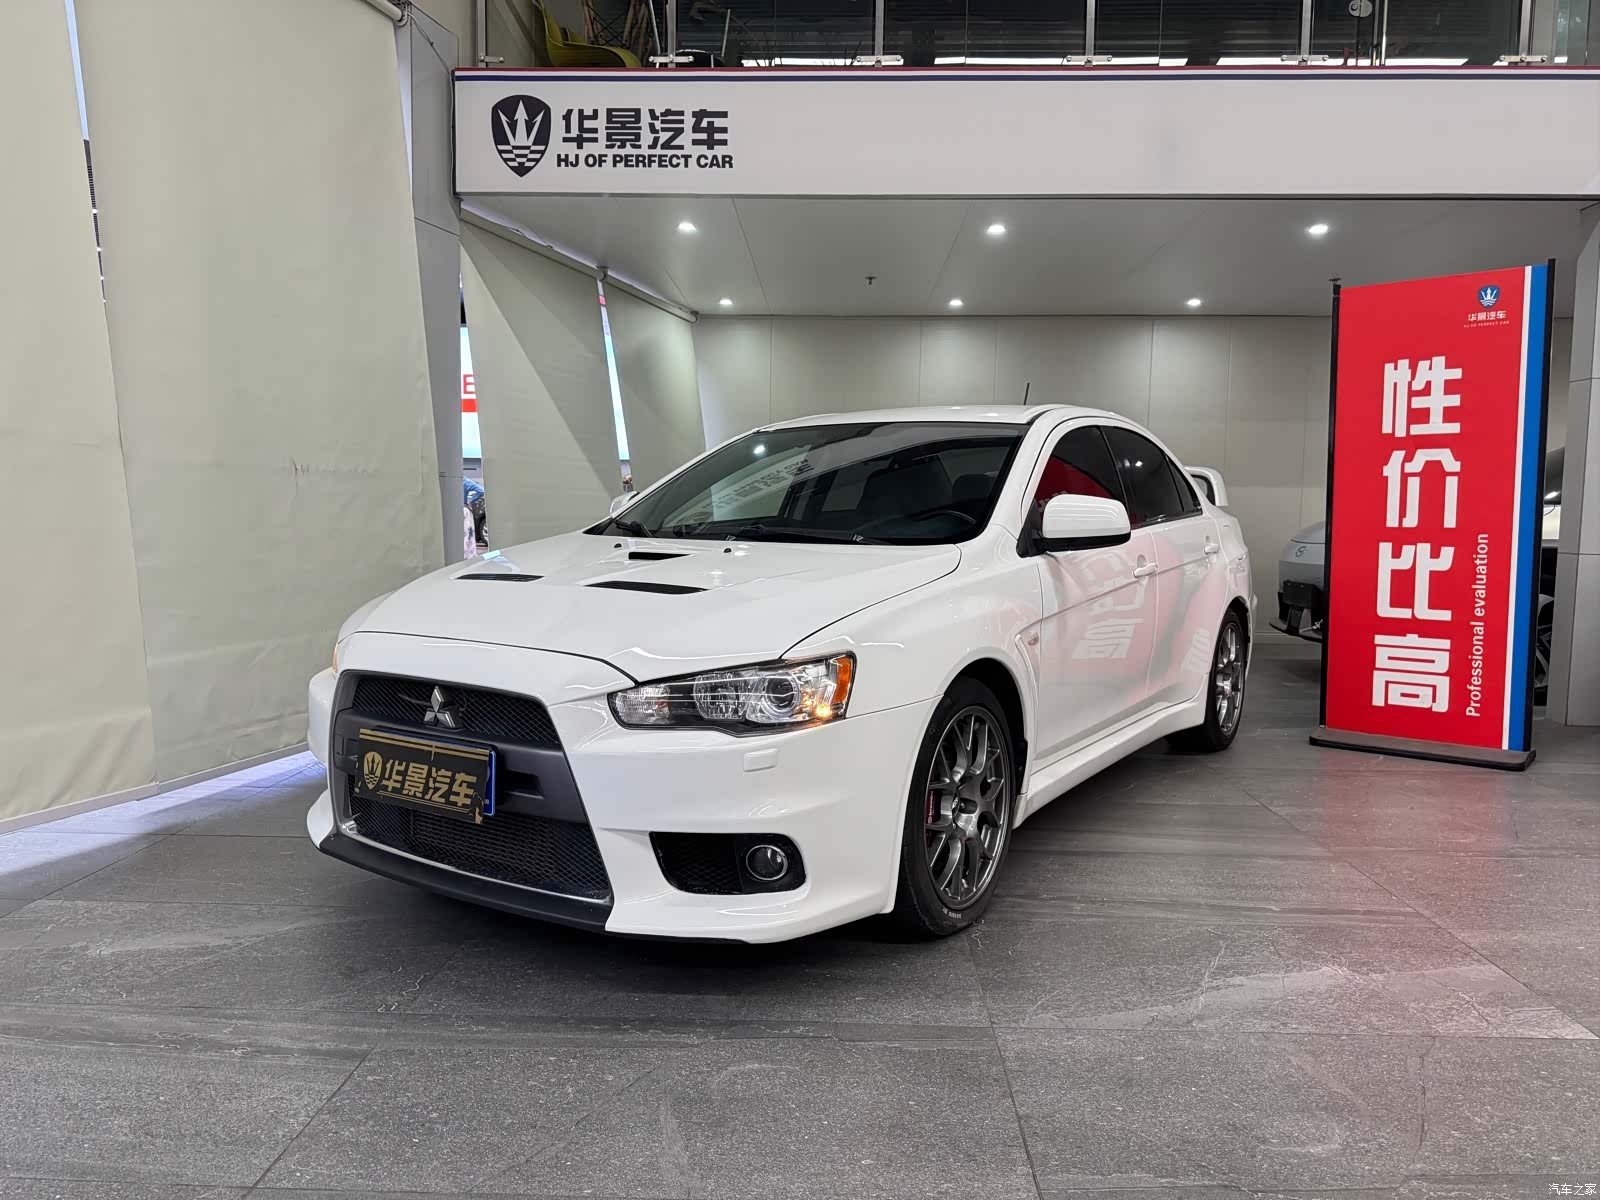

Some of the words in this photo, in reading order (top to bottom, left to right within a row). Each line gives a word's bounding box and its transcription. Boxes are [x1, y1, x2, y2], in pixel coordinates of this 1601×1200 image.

[562, 108, 729, 151] 华景汽车
[556, 153, 580, 168] HJ
[583, 153, 609, 168] OF
[612, 153, 693, 168] PERFECT
[695, 153, 734, 169] CAR
[1468, 311, 1506, 321] 华景汽车
[1372, 355, 1463, 712] 性价比高
[1472, 533, 1489, 616] evaluation
[1466, 621, 1484, 717] Professional
[381, 759, 478, 806] 华景汽车
